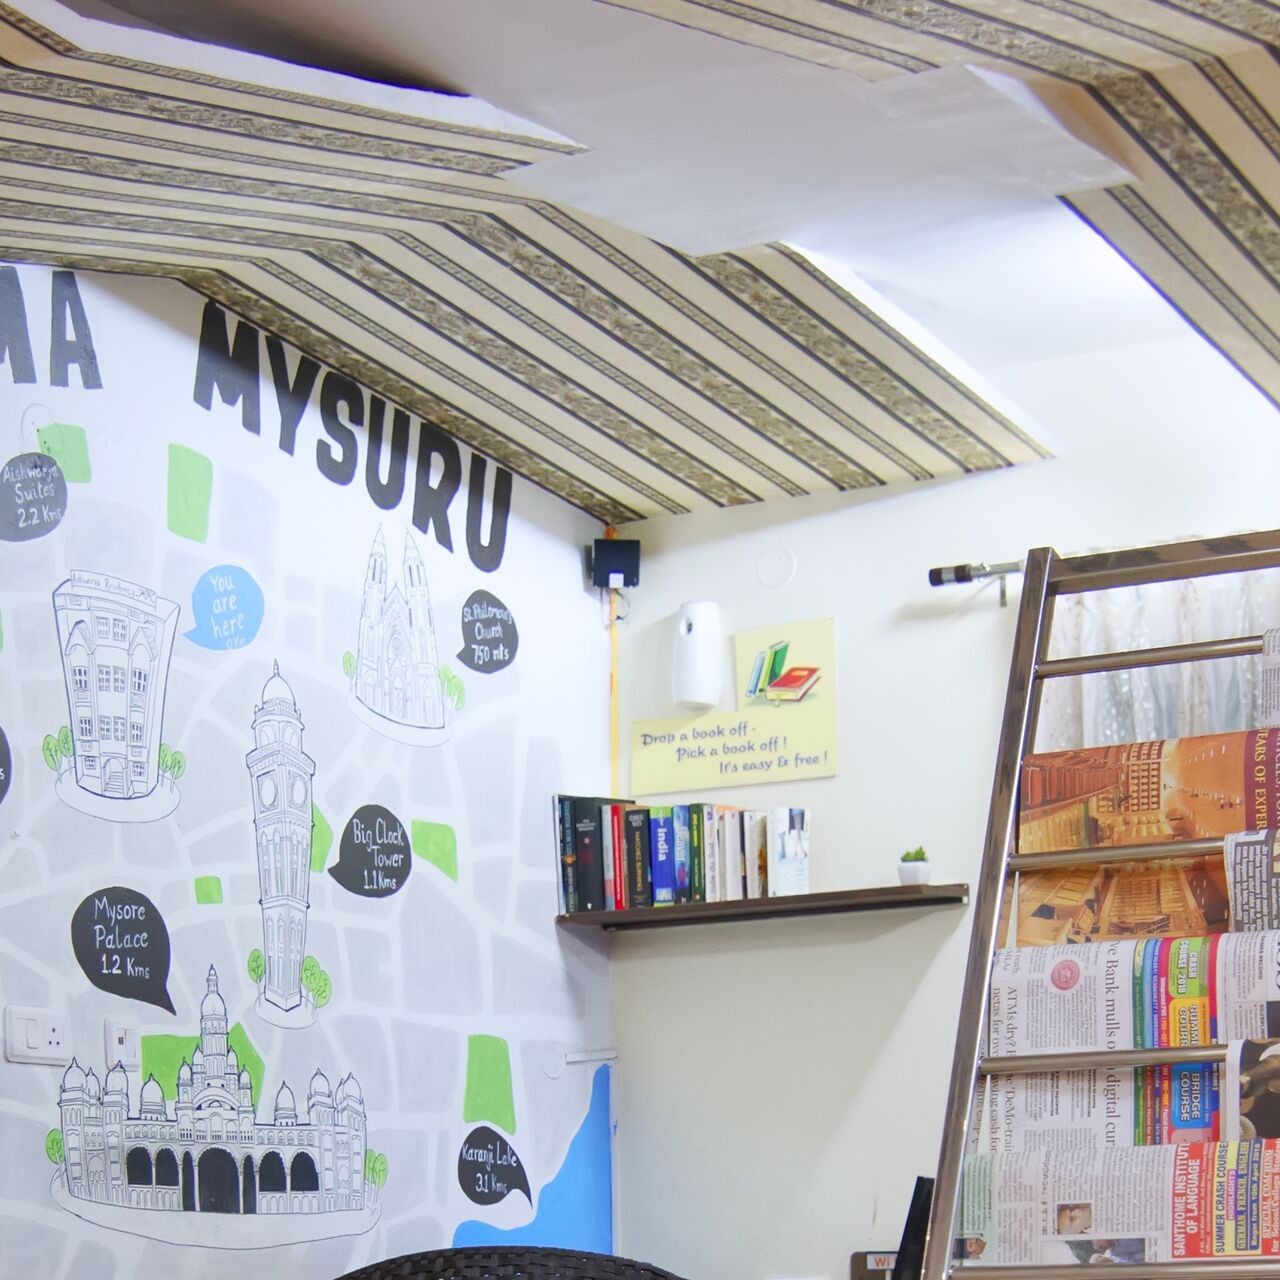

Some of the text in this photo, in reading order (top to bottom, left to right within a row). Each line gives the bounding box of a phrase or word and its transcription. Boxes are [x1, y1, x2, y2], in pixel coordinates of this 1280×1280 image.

[192, 299, 513, 573] MYSURU
[15, 482, 55, 504] Suites
[18, 508, 41, 529] 2.2
[209, 574, 235, 593] You
[212, 595, 237, 614] are
[211, 613, 245, 639] here
[471, 644, 490, 664] 750
[640, 721, 748, 747] Drop a book off
[676, 736, 779, 762] Pick a book off
[720, 752, 820, 774] It's easy & free
[1255, 766, 1266, 784] OF
[352, 818, 373, 851] Big
[657, 828, 668, 861] India
[371, 845, 404, 868] Tower
[94, 896, 146, 927] Mysore
[94, 925, 148, 950] Palace
[102, 954, 150, 979] 1.2 Kms
[1188, 952, 1198, 977] CRASH
[1006, 987, 1018, 1021] ATMs
[1103, 960, 1121, 1118] Bank mulls digital
[990, 988, 1005, 1135] netas for cash
[1180, 1071, 1189, 1121] COURSE
[1191, 1073, 1200, 1118] BRIDGE
[462, 1143, 494, 1171] Karanji
[1187, 1159, 1200, 1216] LANGUAGE
[1174, 1197, 1186, 1255] SANTHOME
[1187, 1219, 1198, 1233] OF
[1216, 1181, 1225, 1253] SUMMER CRASH
